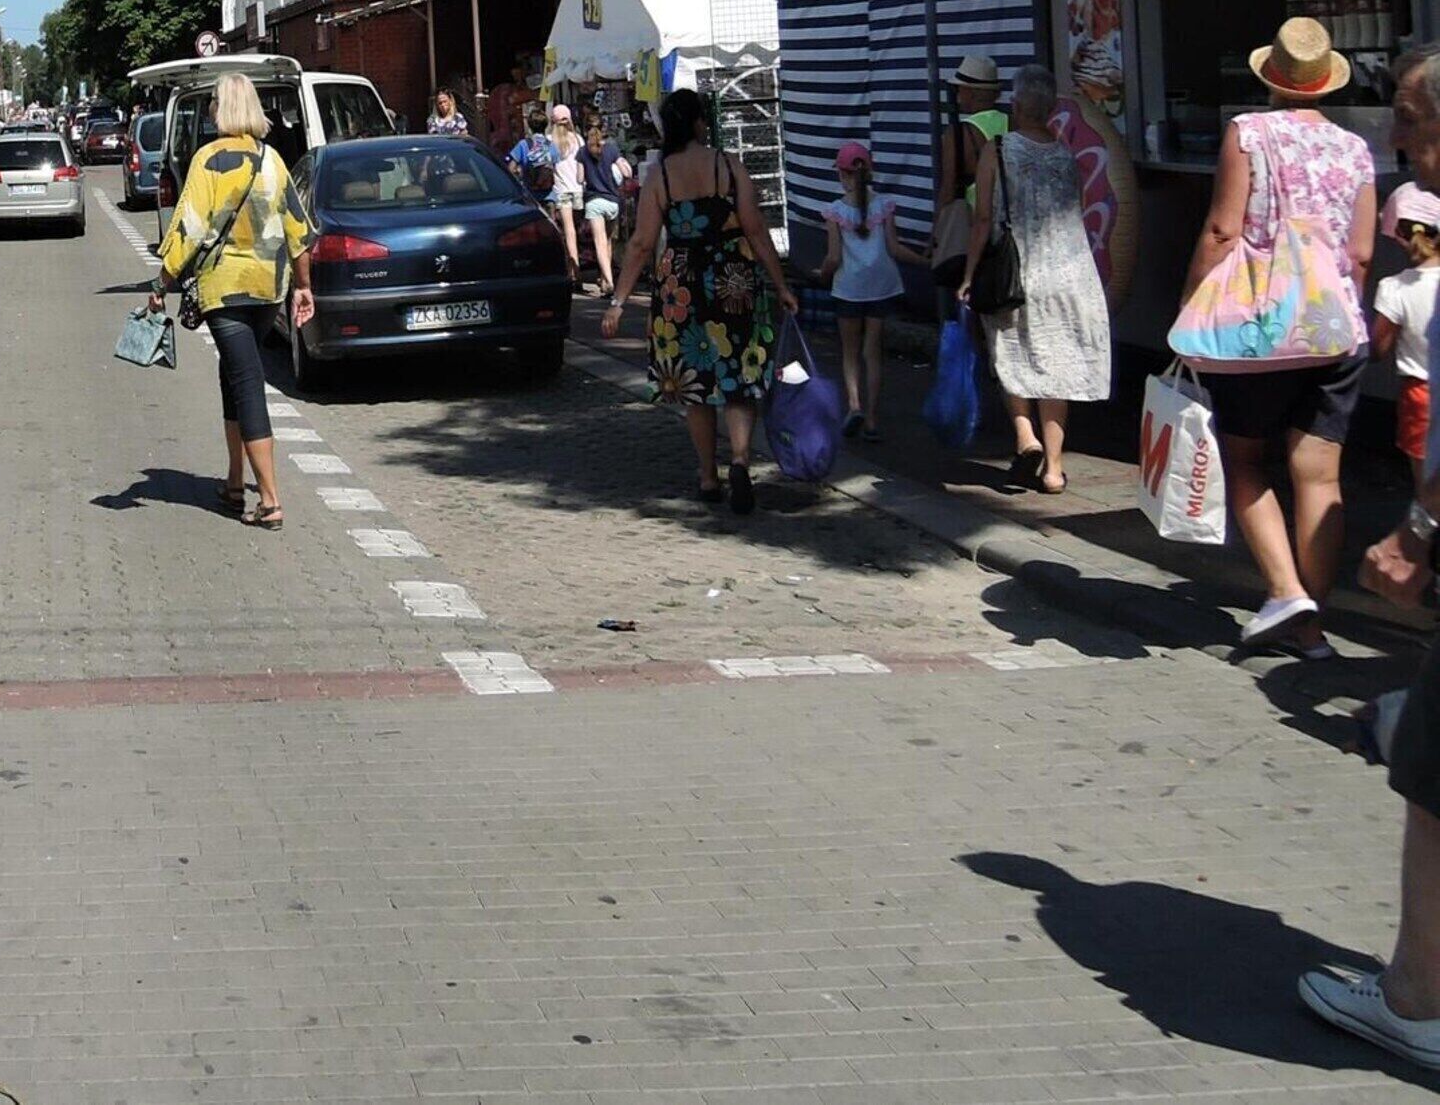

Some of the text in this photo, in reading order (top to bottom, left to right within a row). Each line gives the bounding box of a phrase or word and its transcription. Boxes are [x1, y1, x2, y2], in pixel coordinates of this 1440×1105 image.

[414, 301, 488, 324] ZKA 02356
[1142, 410, 1173, 499] M
[1186, 437, 1210, 518] MIGROS
